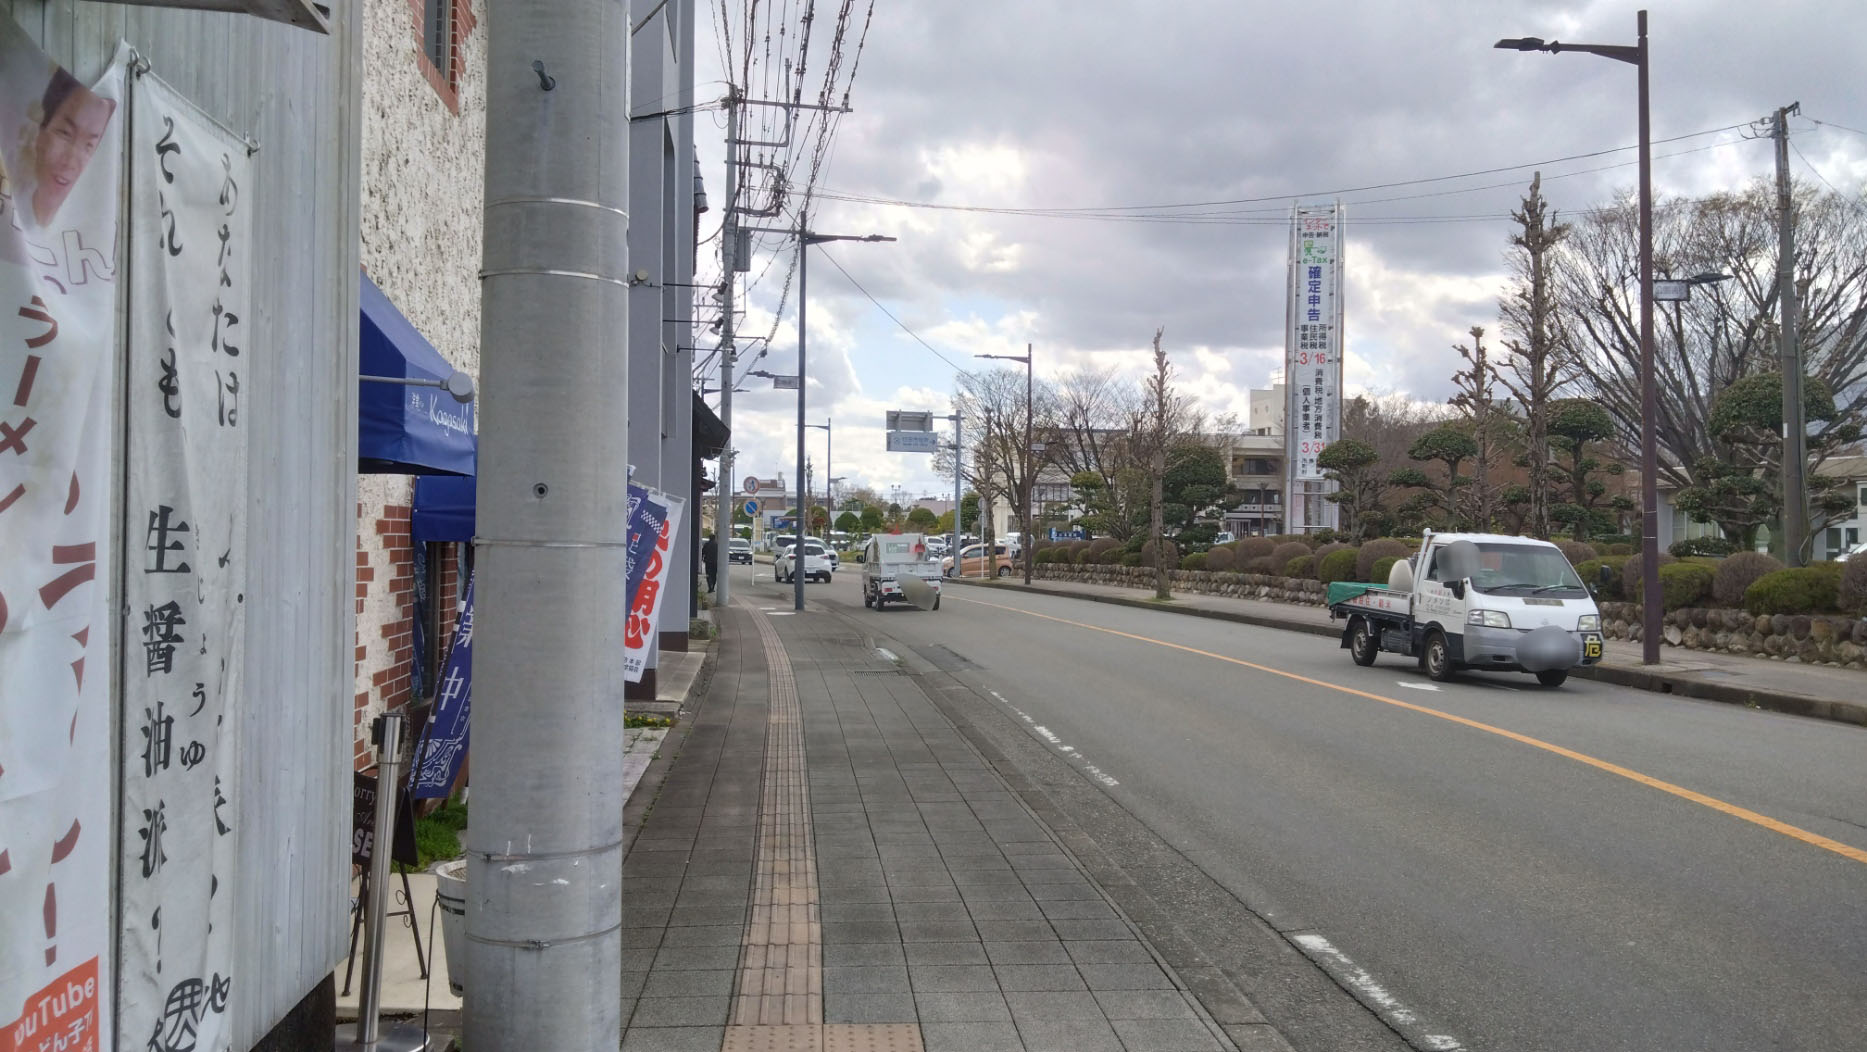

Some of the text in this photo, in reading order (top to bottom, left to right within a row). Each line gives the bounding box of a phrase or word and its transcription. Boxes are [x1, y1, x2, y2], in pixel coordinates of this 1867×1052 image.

[155, 114, 184, 419] それも
[1302, 255, 1328, 264] e-Tax
[211, 152, 241, 428] あなたは
[1308, 266, 1322, 322] 確定申告
[1300, 324, 1309, 350] 事業税
[1309, 324, 1318, 350] 住民税
[1318, 324, 1327, 350] 所得税
[1300, 352, 1326, 366] 3/16
[1584, 634, 1601, 657] 危
[353, 787, 376, 807] orry
[15, 976, 96, 1048] ouTube
